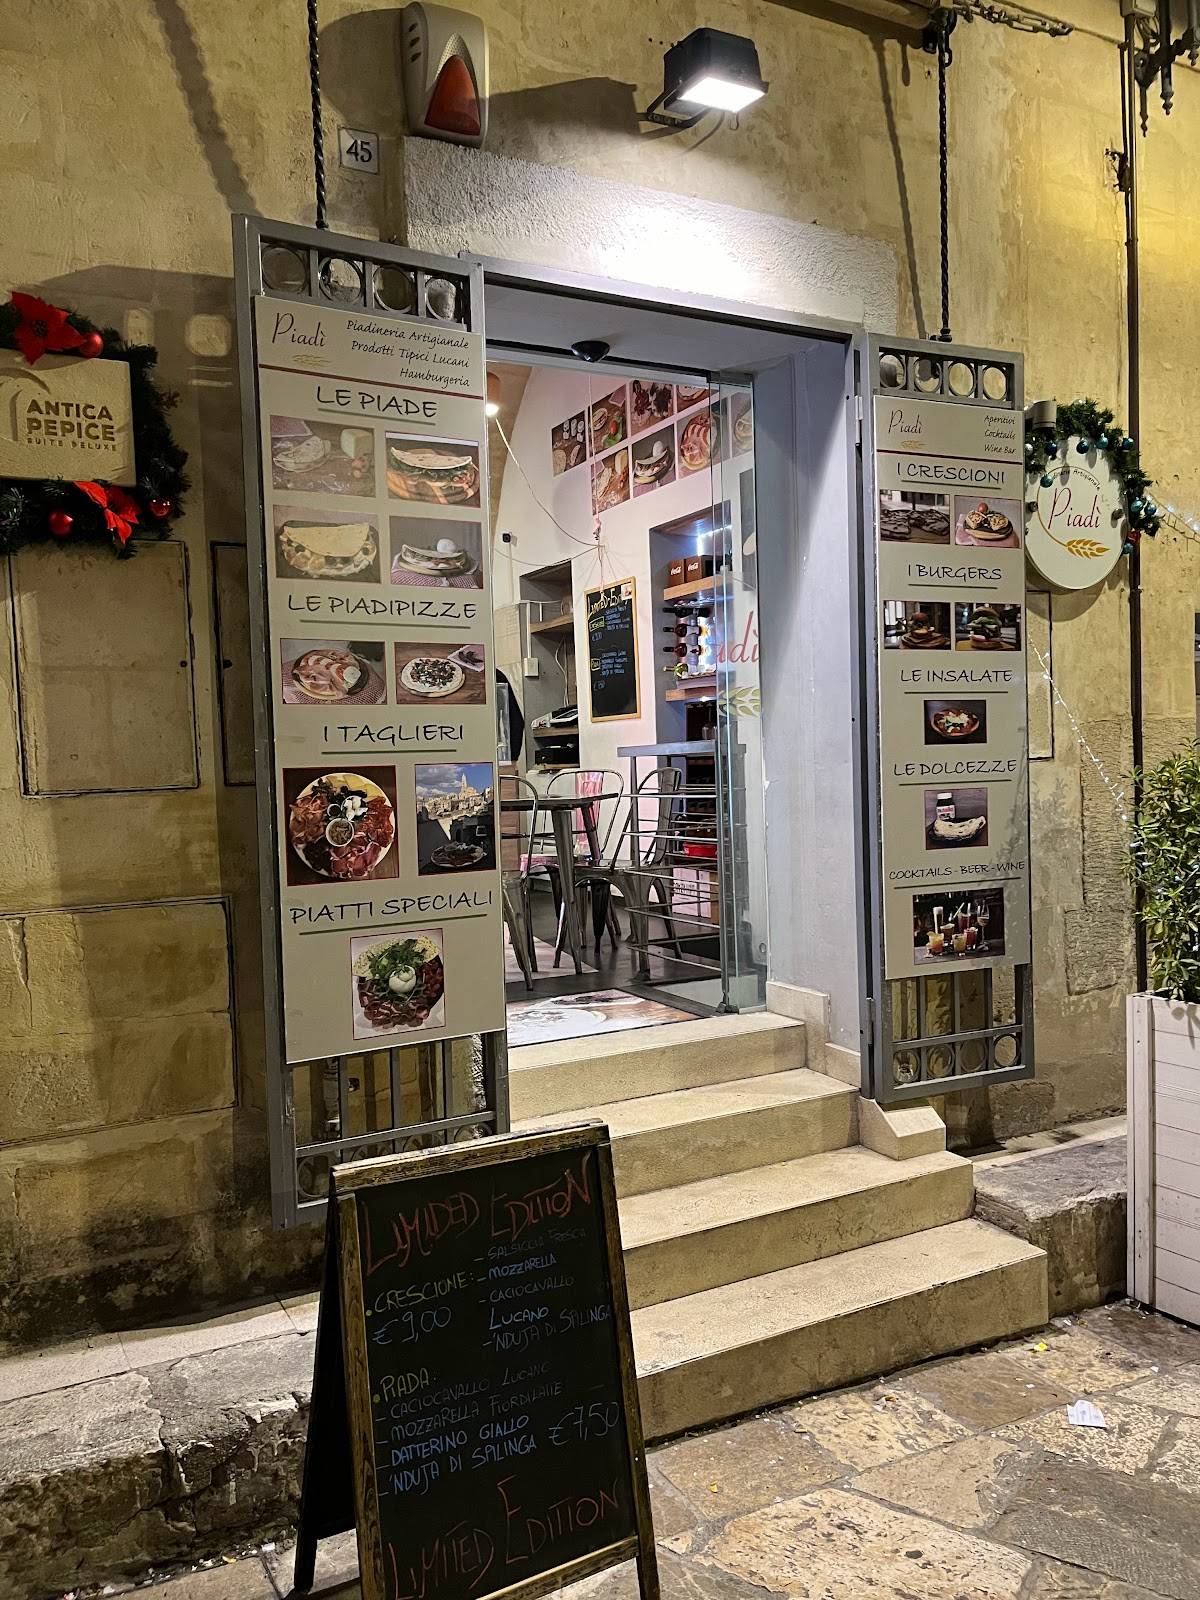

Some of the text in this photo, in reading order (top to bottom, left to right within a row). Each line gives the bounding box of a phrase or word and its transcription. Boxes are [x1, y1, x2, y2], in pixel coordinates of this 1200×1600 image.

[346, 139, 372, 163] 45
[271, 312, 326, 347] Piadì
[347, 320, 469, 349] Piadineria Artigianale
[351, 340, 470, 368] Prodotti Tipici Lucani
[400, 369, 470, 389] Hamburgeria
[26, 399, 113, 421] ANTICA
[317, 386, 438, 418] LE PIADE
[26, 418, 115, 442] PEPICE
[888, 409, 923, 435] Piadì
[984, 415, 1016, 427] Aperitivi
[27, 437, 117, 452] SUITE DELUXE
[984, 429, 1017, 440] Cocktails
[984, 444, 1017, 454] Wine Bar
[907, 463, 1005, 484] CRESCIONI
[1048, 487, 1102, 530] Piadì
[916, 564, 1002, 582] BURGERS
[288, 594, 477, 620] LE PIADIPIZZE
[900, 669, 1013, 683] LE INSALATE
[323, 724, 464, 746] I TAGLIERI
[894, 759, 1017, 776] LE DOLCEZZE
[889, 867, 952, 881] COCKTAILS
[960, 864, 989, 875] BEER
[996, 861, 1025, 873] WINE
[290, 890, 493, 925] PIATTI SPECIALI
[488, 1252, 557, 1281] MOZZARELLA
[489, 1275, 575, 1304] CACIOCAVALLO
[489, 1305, 549, 1330] LUCANO
[390, 1379, 490, 1419] CACIOCAVALLO
[390, 1402, 480, 1442] MOZZARELLA
[391, 1415, 529, 1467] DATTERINO GIALLO
[449, 1453, 463, 1473] DI
[471, 1434, 537, 1470] SPILINGA
[497, 1474, 619, 1565] EDITION
